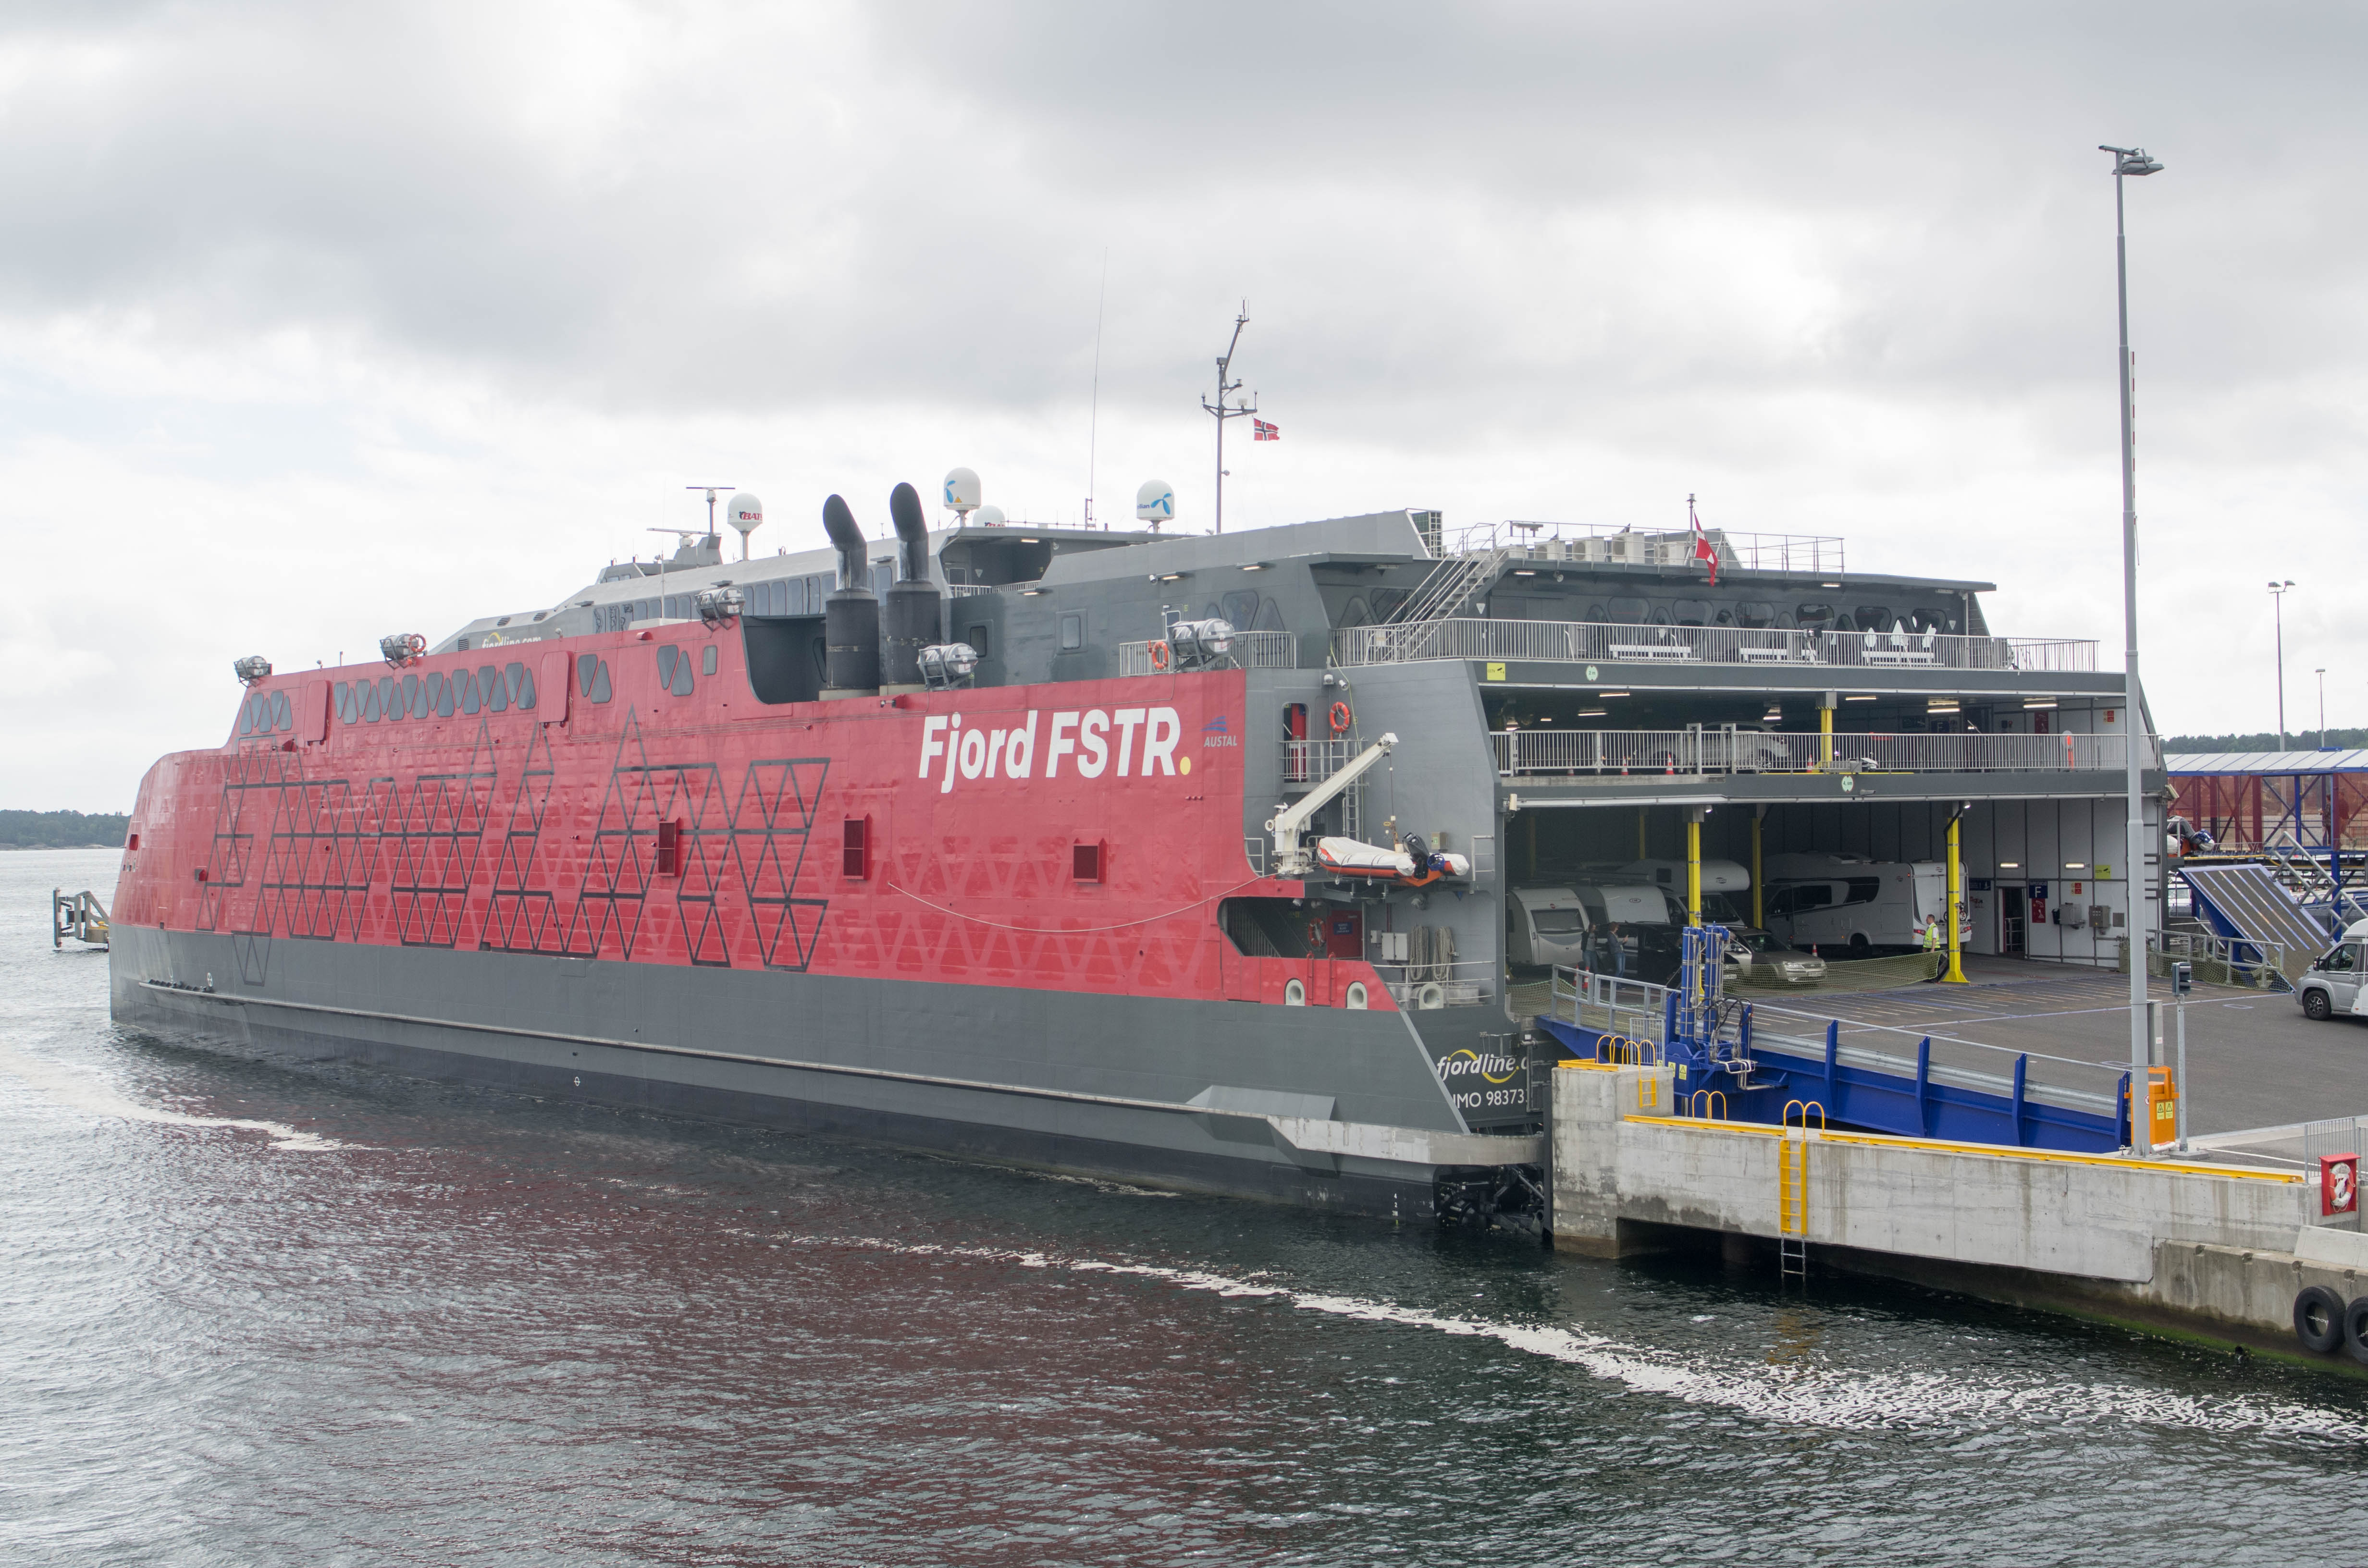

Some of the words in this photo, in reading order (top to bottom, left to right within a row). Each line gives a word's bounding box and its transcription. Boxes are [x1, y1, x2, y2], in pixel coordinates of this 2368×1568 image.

[482, 636, 542, 649] fjordlinecom
[1204, 735, 1237, 747] AUSTAL
[918, 710, 1038, 793] Fjord
[1046, 707, 1191, 778] FSTR.
[2035, 886, 2042, 898] F
[1453, 1092, 1481, 1108] IMO
[1486, 1089, 1528, 1106] 98373
